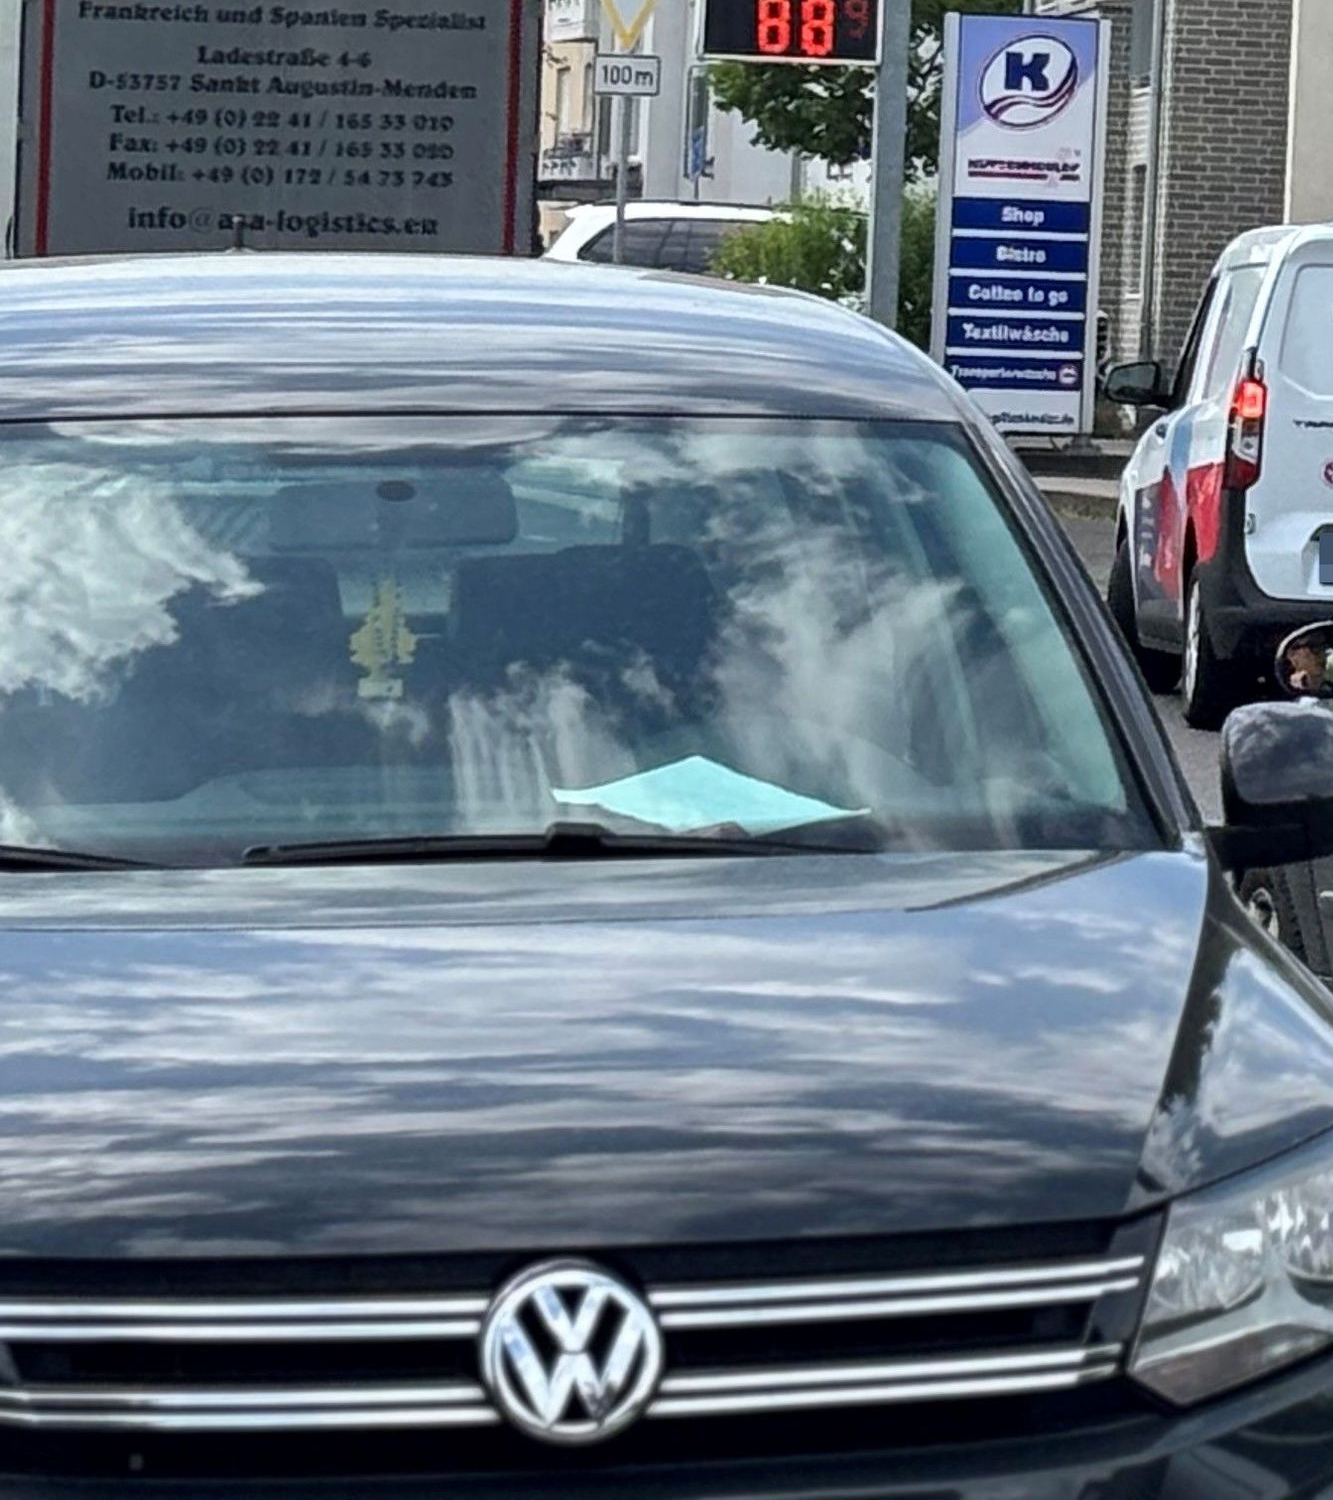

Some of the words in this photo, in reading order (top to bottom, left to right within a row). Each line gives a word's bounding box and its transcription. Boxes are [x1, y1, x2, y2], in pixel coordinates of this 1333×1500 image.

[79, 0, 209, 23] Frankreich
[216, 5, 263, 25] und
[270, 6, 367, 28] Spanien
[373, 9, 486, 31] Spezialist
[197, 45, 331, 67] Ladestraße
[602, 65, 632, 85] 100
[635, 70, 654, 86] m
[1003, 52, 1051, 92] K
[89, 70, 180, 91] D-53757
[190, 73, 260, 93] Sankt
[267, 76, 477, 99] Augustin-Menden
[166, 108, 208, 125] +49
[215, 108, 247, 128] (0)
[252, 110, 280, 128] 22
[288, 113, 311, 128] 41
[336, 113, 372, 129] 165
[379, 114, 406, 130] 33
[110, 132, 158, 152] Fax:
[166, 137, 208, 154] +49
[214, 136, 246, 156] (0)
[253, 139, 280, 155] 22
[287, 141, 311, 156] 41
[336, 141, 372, 158] 165
[380, 142, 405, 159] 33
[192, 166, 234, 184] +49
[241, 165, 274, 185] (0)
[1001, 206, 1045, 227] Shop
[996, 246, 1047, 263] Bistro
[968, 284, 1023, 302] Coffee
[1028, 287, 1045, 302] to
[1048, 290, 1068, 307] go
[962, 322, 1070, 343] Textilwäsche
